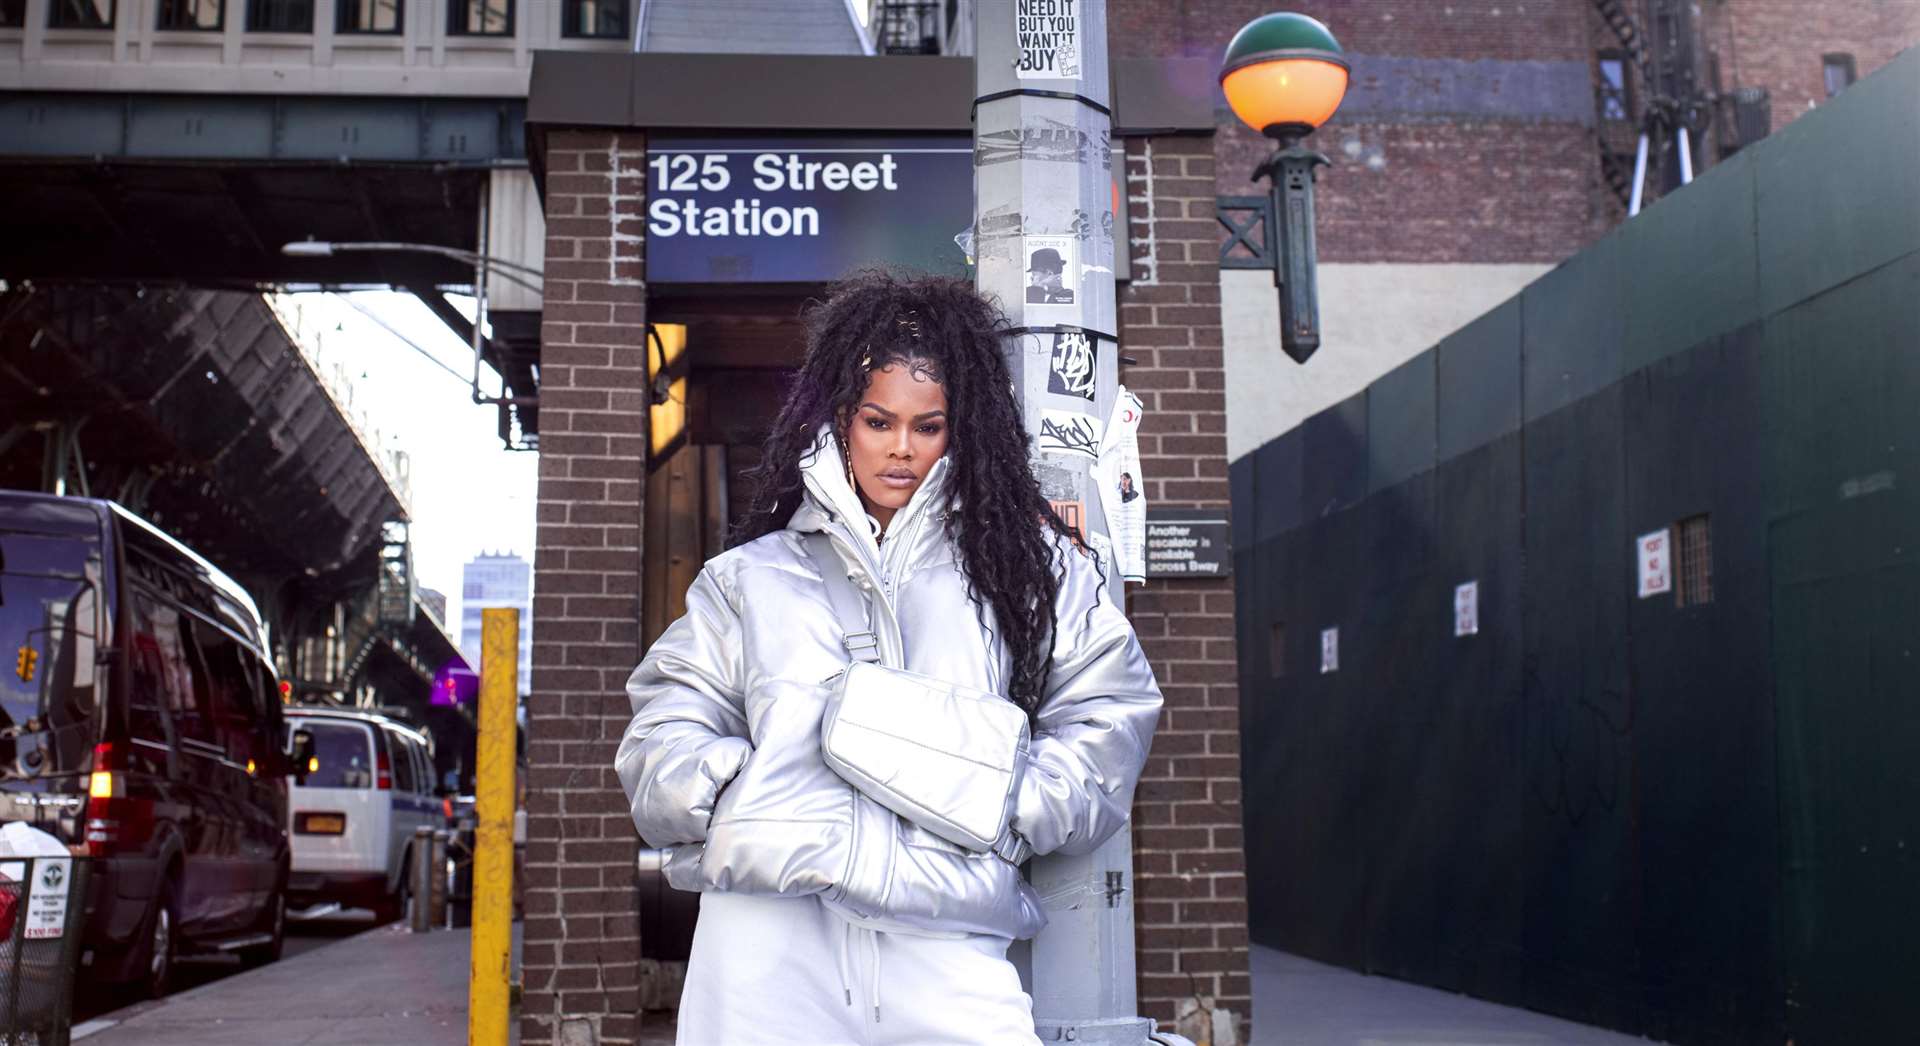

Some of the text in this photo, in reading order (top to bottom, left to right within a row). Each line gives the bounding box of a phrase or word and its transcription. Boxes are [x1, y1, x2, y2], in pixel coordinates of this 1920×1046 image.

[1018, 0, 1074, 16] NEED IT
[1019, 16, 1075, 32] BUT YOU
[1018, 32, 1060, 49] WANT
[1020, 49, 1056, 72] BUY
[649, 154, 898, 191] 125 Street
[649, 199, 820, 236] Station
[1148, 525, 1191, 537] Another
[1148, 536, 1211, 548] escalator is
[1149, 549, 1195, 560] available
[1150, 560, 1220, 574] across Bway
